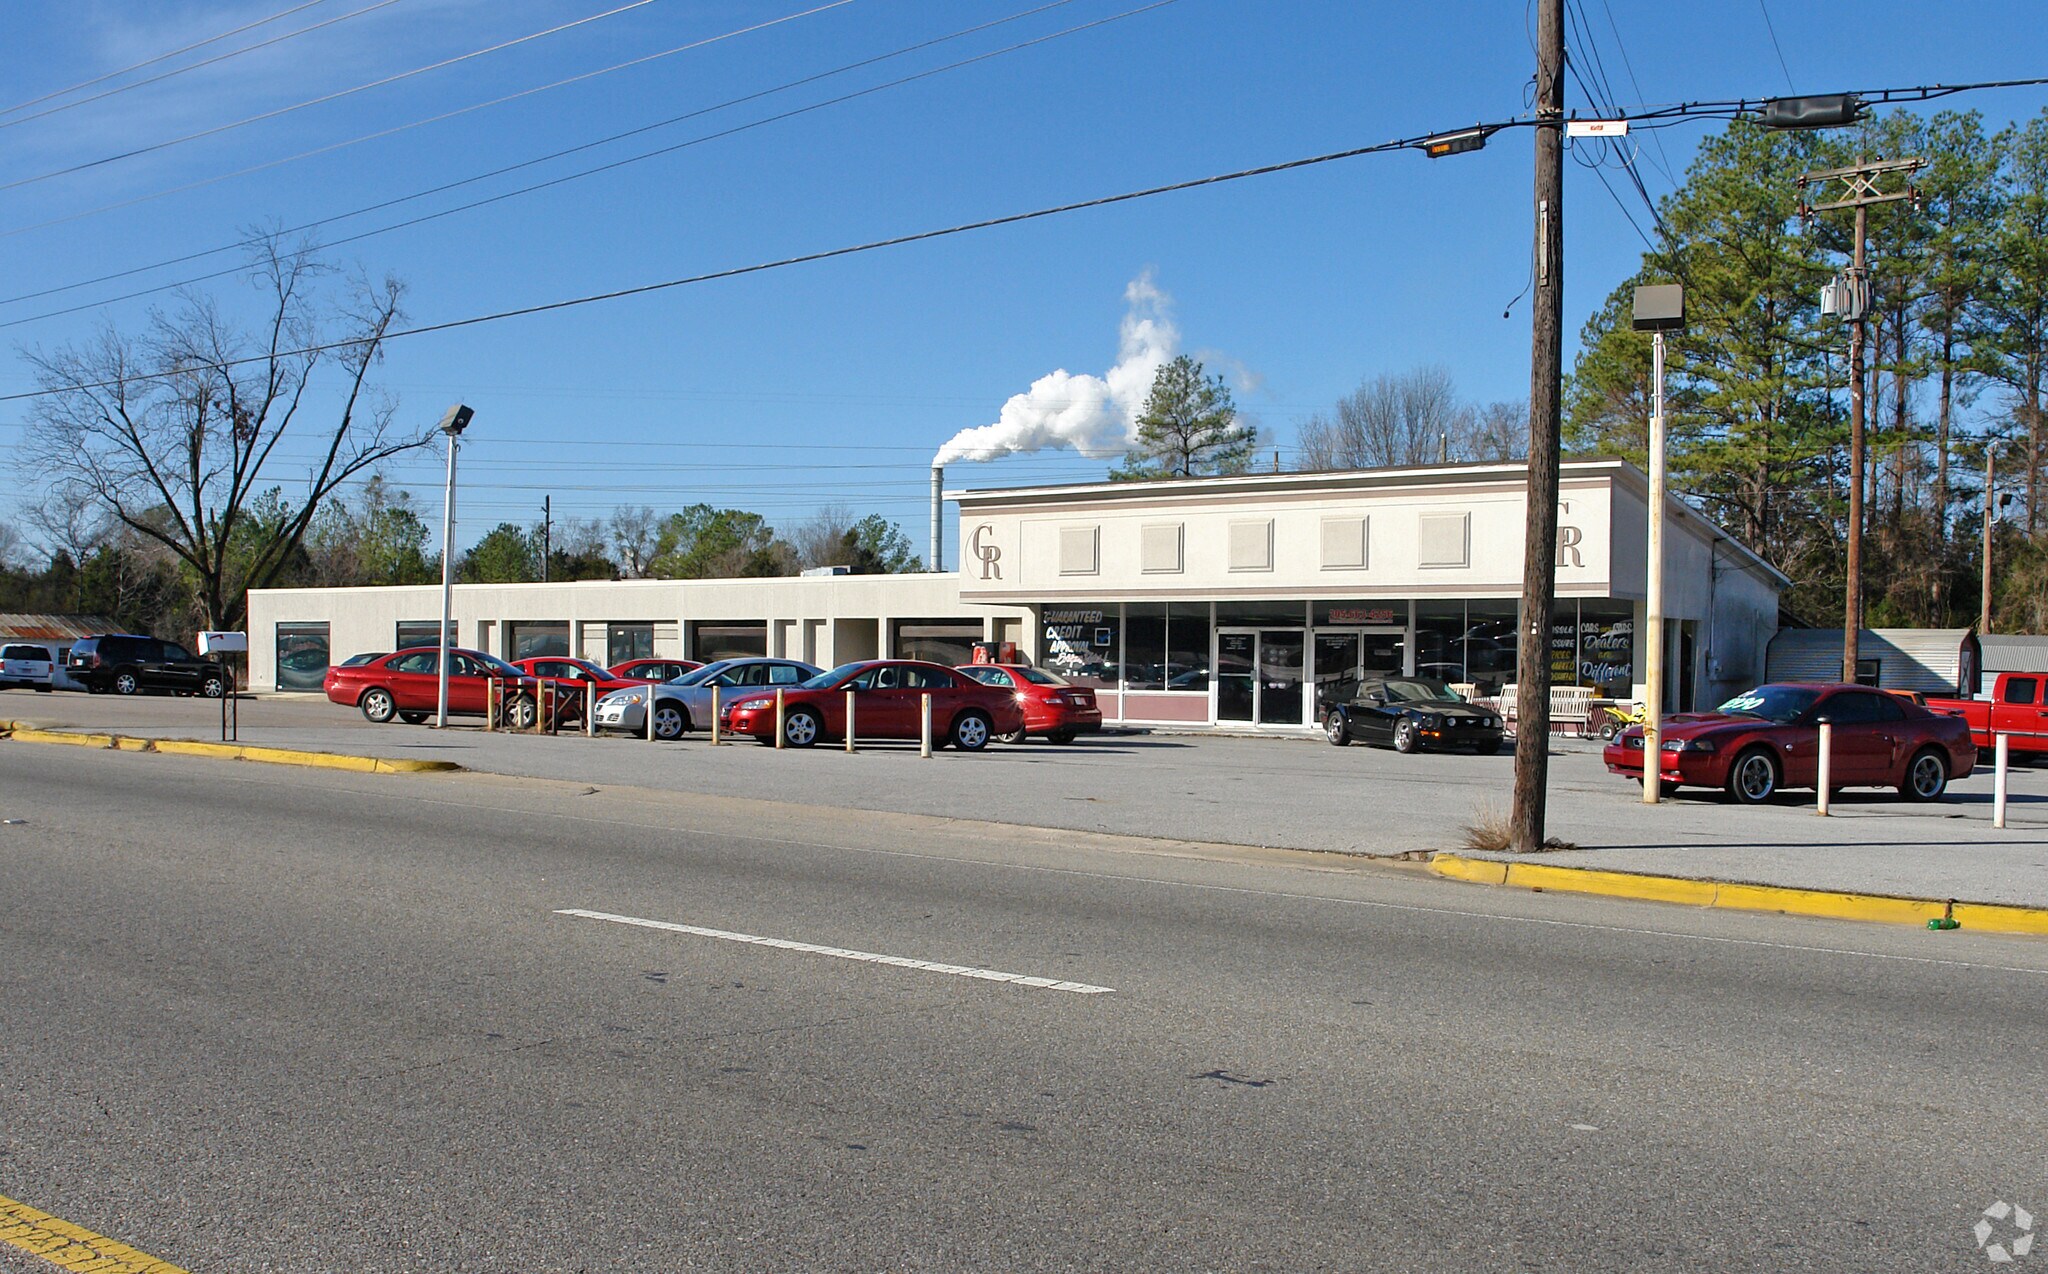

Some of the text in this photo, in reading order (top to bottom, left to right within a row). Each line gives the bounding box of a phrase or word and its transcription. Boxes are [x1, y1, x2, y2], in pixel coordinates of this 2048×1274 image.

[1043, 610, 1103, 624] GUARANTEED
[1045, 625, 1083, 640] CREDIT
[1552, 625, 1575, 634] SSLE
[1581, 622, 1600, 633] CARS
[1049, 640, 1089, 653] APPROVAL
[1552, 639, 1576, 648] SSURE
[1584, 634, 1630, 649] Dealers
[1581, 661, 1632, 683] Different
